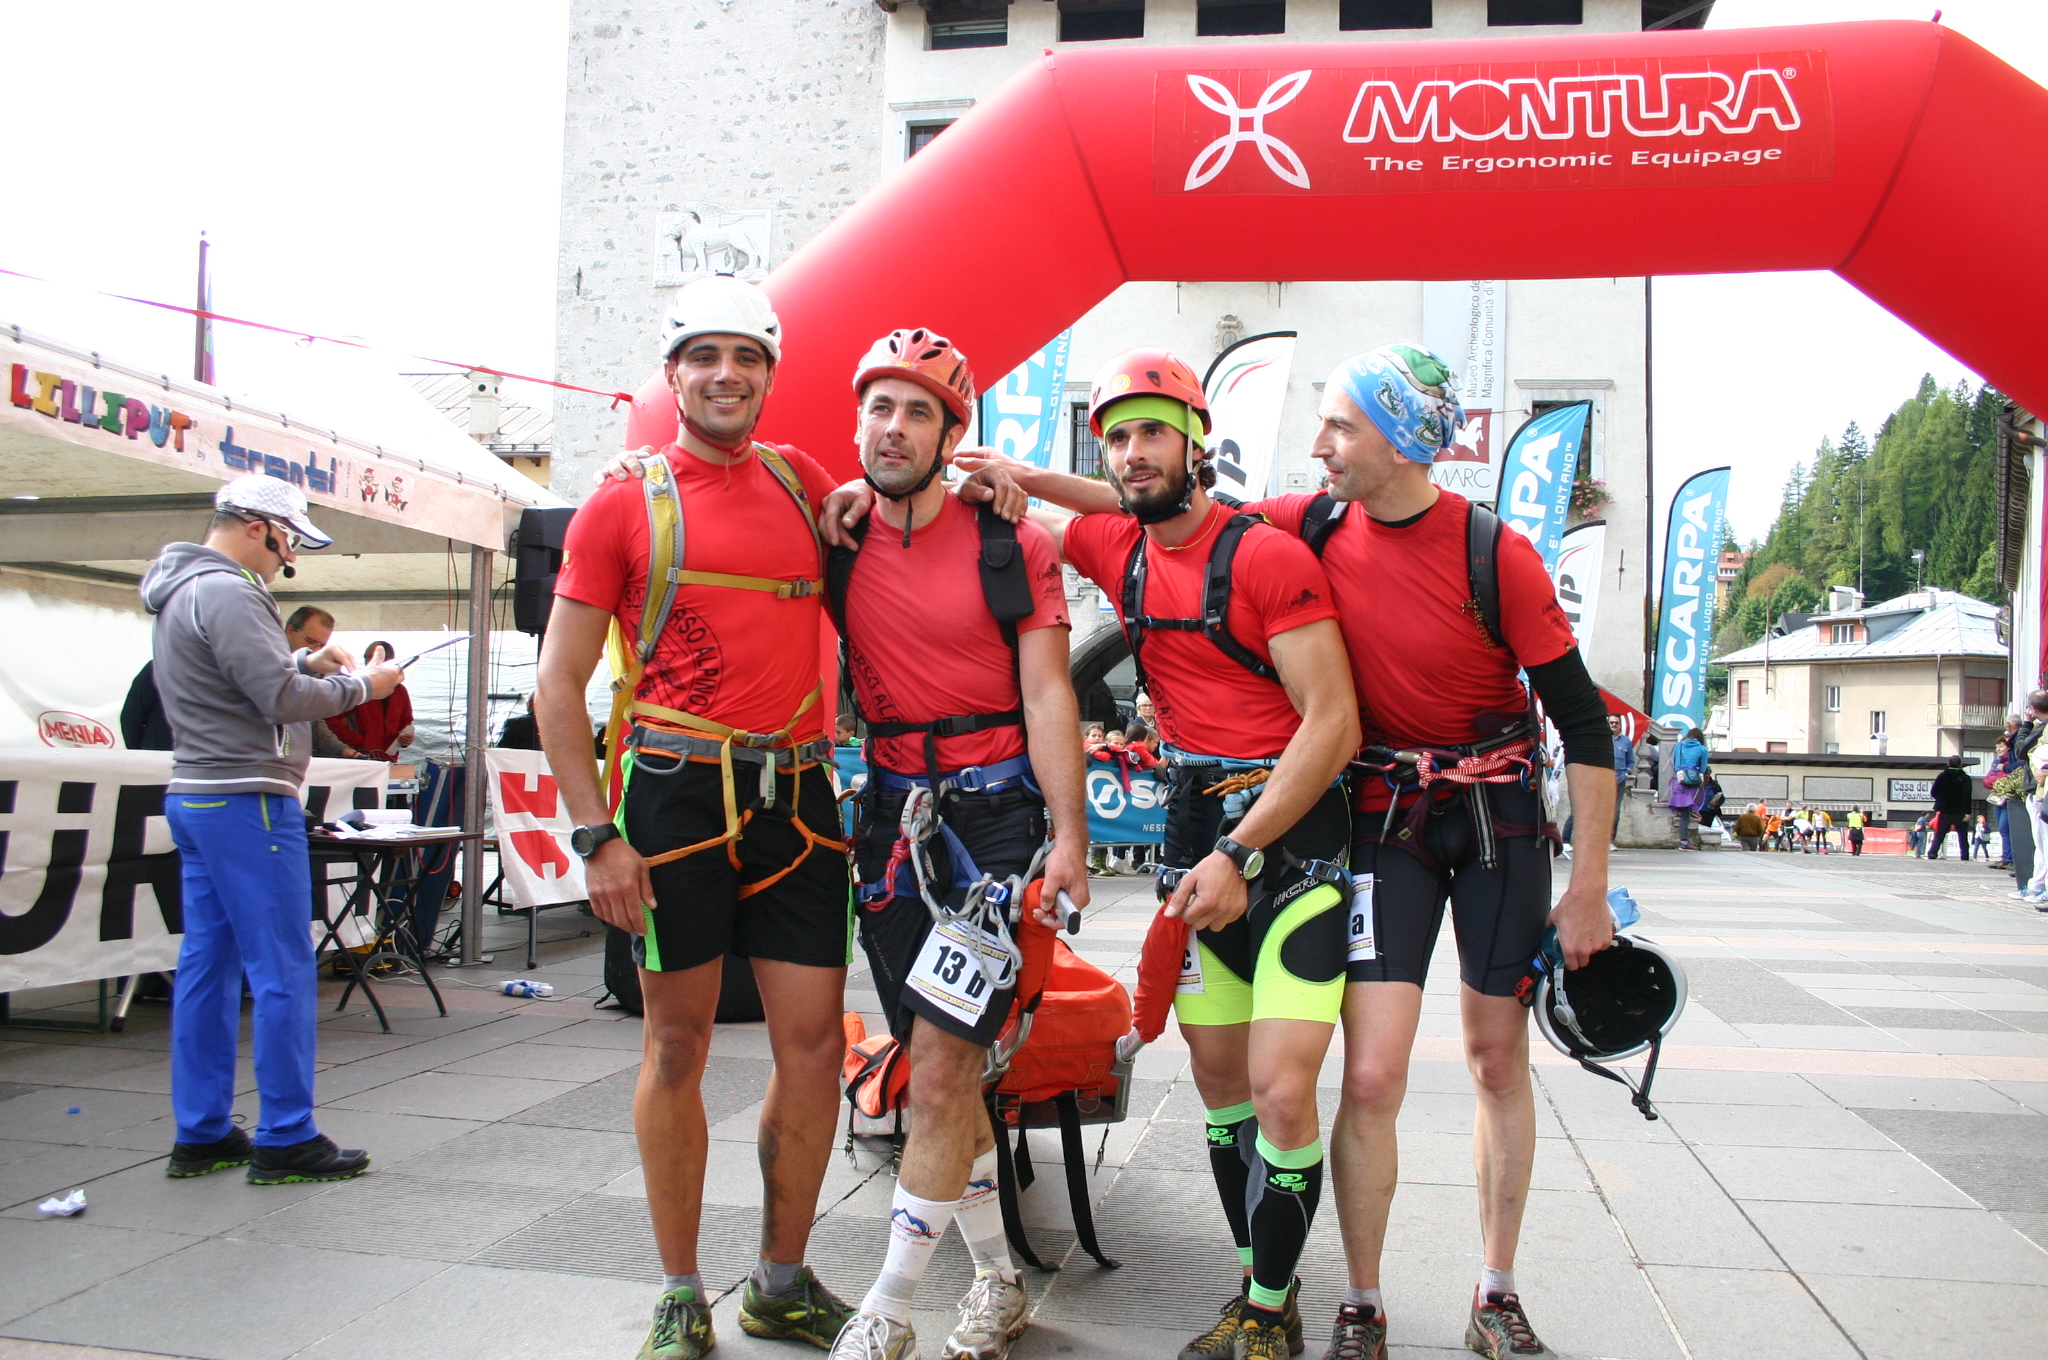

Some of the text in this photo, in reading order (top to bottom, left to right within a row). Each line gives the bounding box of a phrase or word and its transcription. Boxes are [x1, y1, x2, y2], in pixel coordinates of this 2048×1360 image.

[1342, 69, 1801, 143] MONTURA
[1363, 146, 1783, 173] The Ergonomic Equipage
[1483, 287, 1494, 296] di
[1466, 280, 1482, 398] Museo Archeologico de
[1482, 299, 1494, 347] Comunità
[1481, 350, 1494, 398] Magnifica
[11, 363, 192, 453] LILLIPUT
[197, 450, 207, 461] by
[1428, 468, 1491, 488] MARC
[1553, 449, 1575, 525] LONTANO
[1709, 505, 1724, 564] LONTANO
[1662, 491, 1713, 708] SCARPA
[1702, 592, 1714, 632] LUOGO
[688, 646, 719, 707] ALPINO
[1698, 639, 1709, 692] NESSUN
[43, 719, 110, 745] MENIA
[1893, 780, 1929, 791] Casa del
[1351, 913, 1365, 936] a
[932, 945, 968, 985] 13
